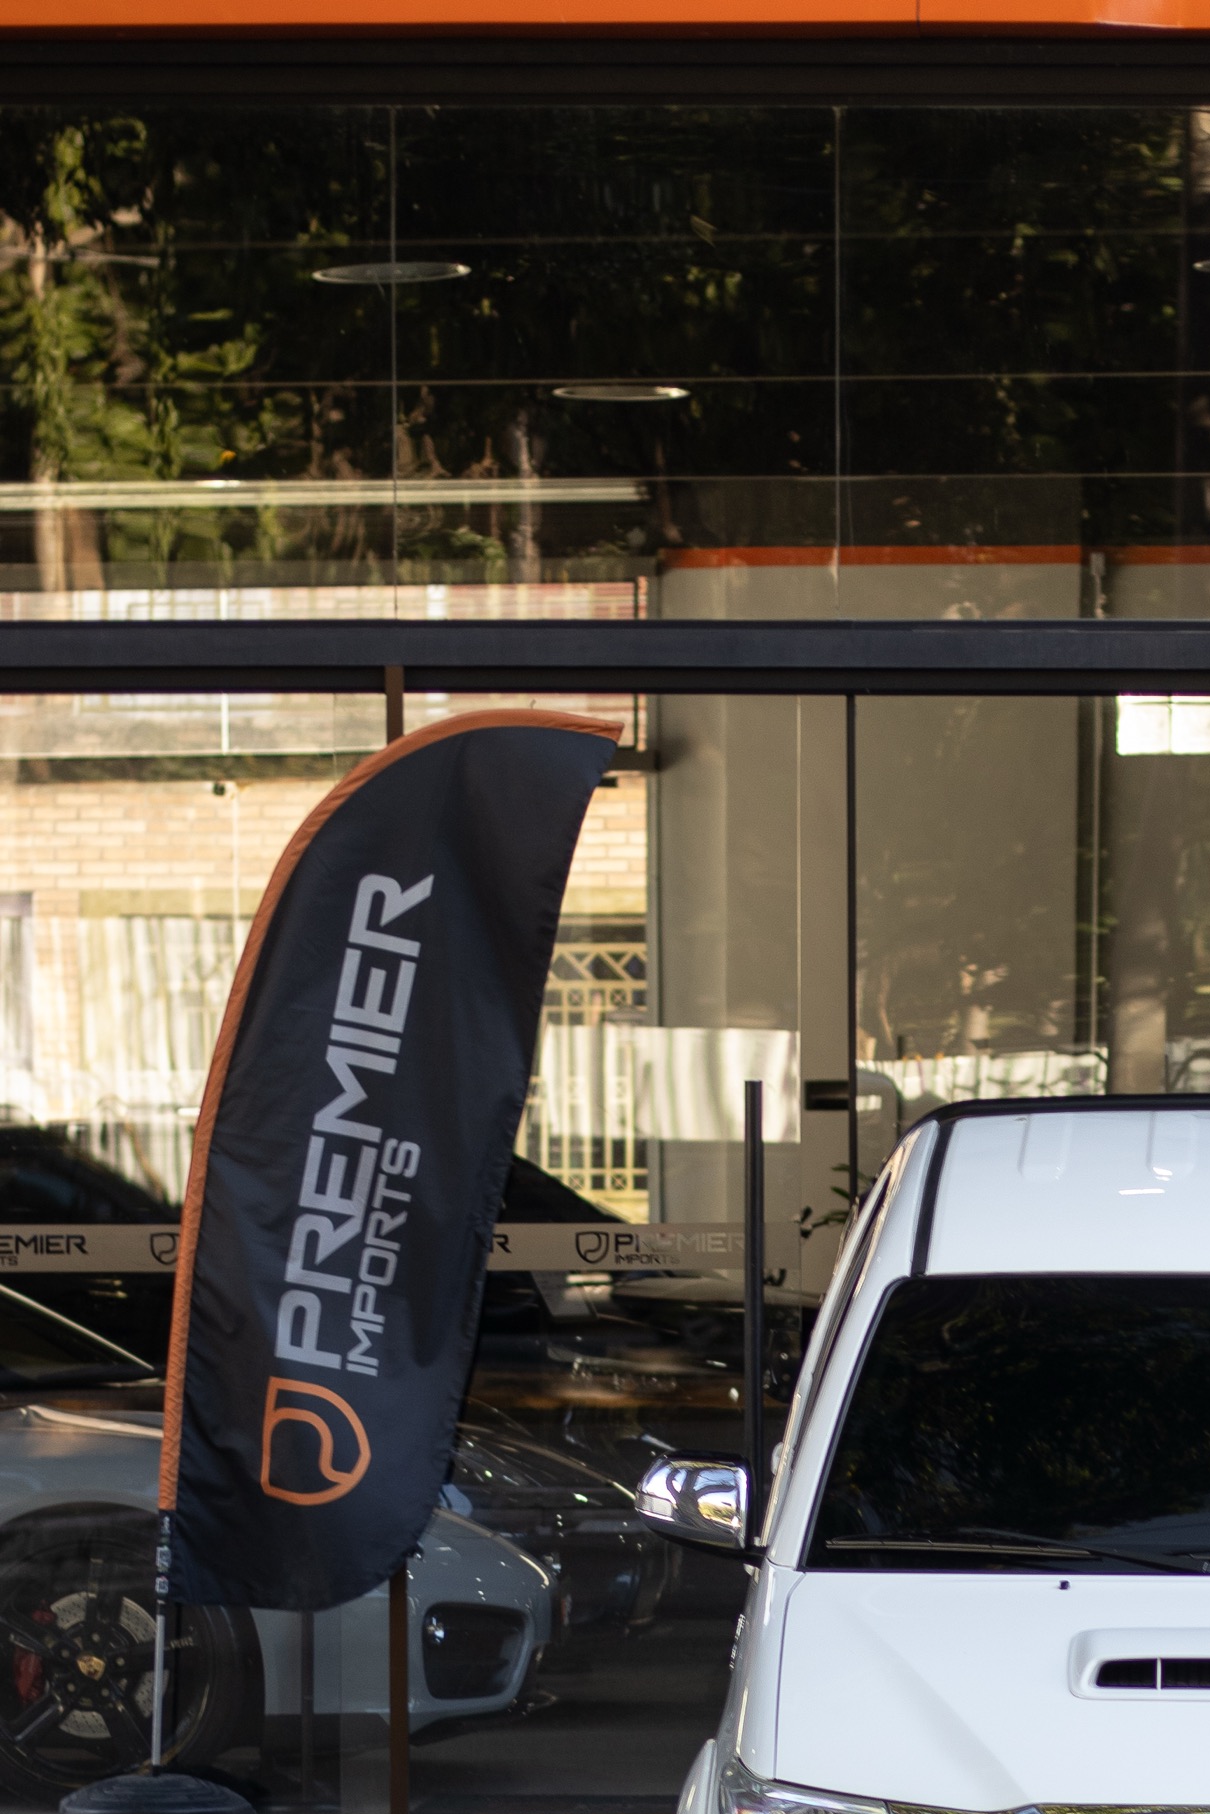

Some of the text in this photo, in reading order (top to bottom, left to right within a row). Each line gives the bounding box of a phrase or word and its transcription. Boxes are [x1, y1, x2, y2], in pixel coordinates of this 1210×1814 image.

[274, 873, 435, 1370] PREMIER
[0, 1234, 88, 1255] EMIER
[345, 1137, 421, 1377] IMPORTS
[615, 1254, 681, 1265] IMPORTS
